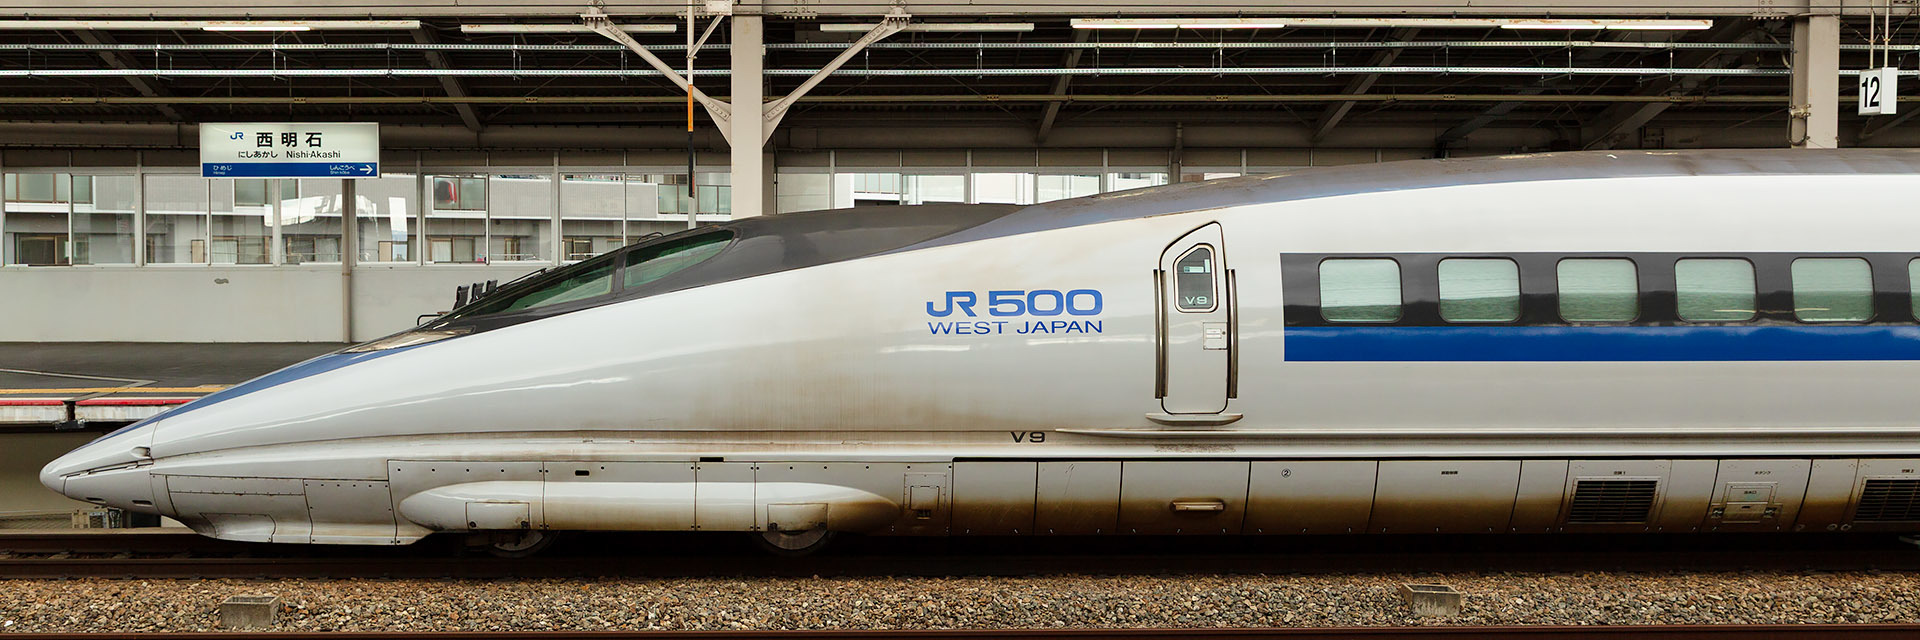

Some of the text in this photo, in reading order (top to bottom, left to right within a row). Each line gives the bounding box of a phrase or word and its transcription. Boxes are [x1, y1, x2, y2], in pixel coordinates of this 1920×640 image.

[1861, 76, 1880, 108] 12
[230, 131, 244, 140] JR
[256, 132, 323, 148] 西明石
[238, 150, 278, 159] にしあかし
[926, 289, 1103, 318] JR 500
[928, 320, 1103, 335] WEST JAPAN
[1010, 431, 1046, 443] V9
